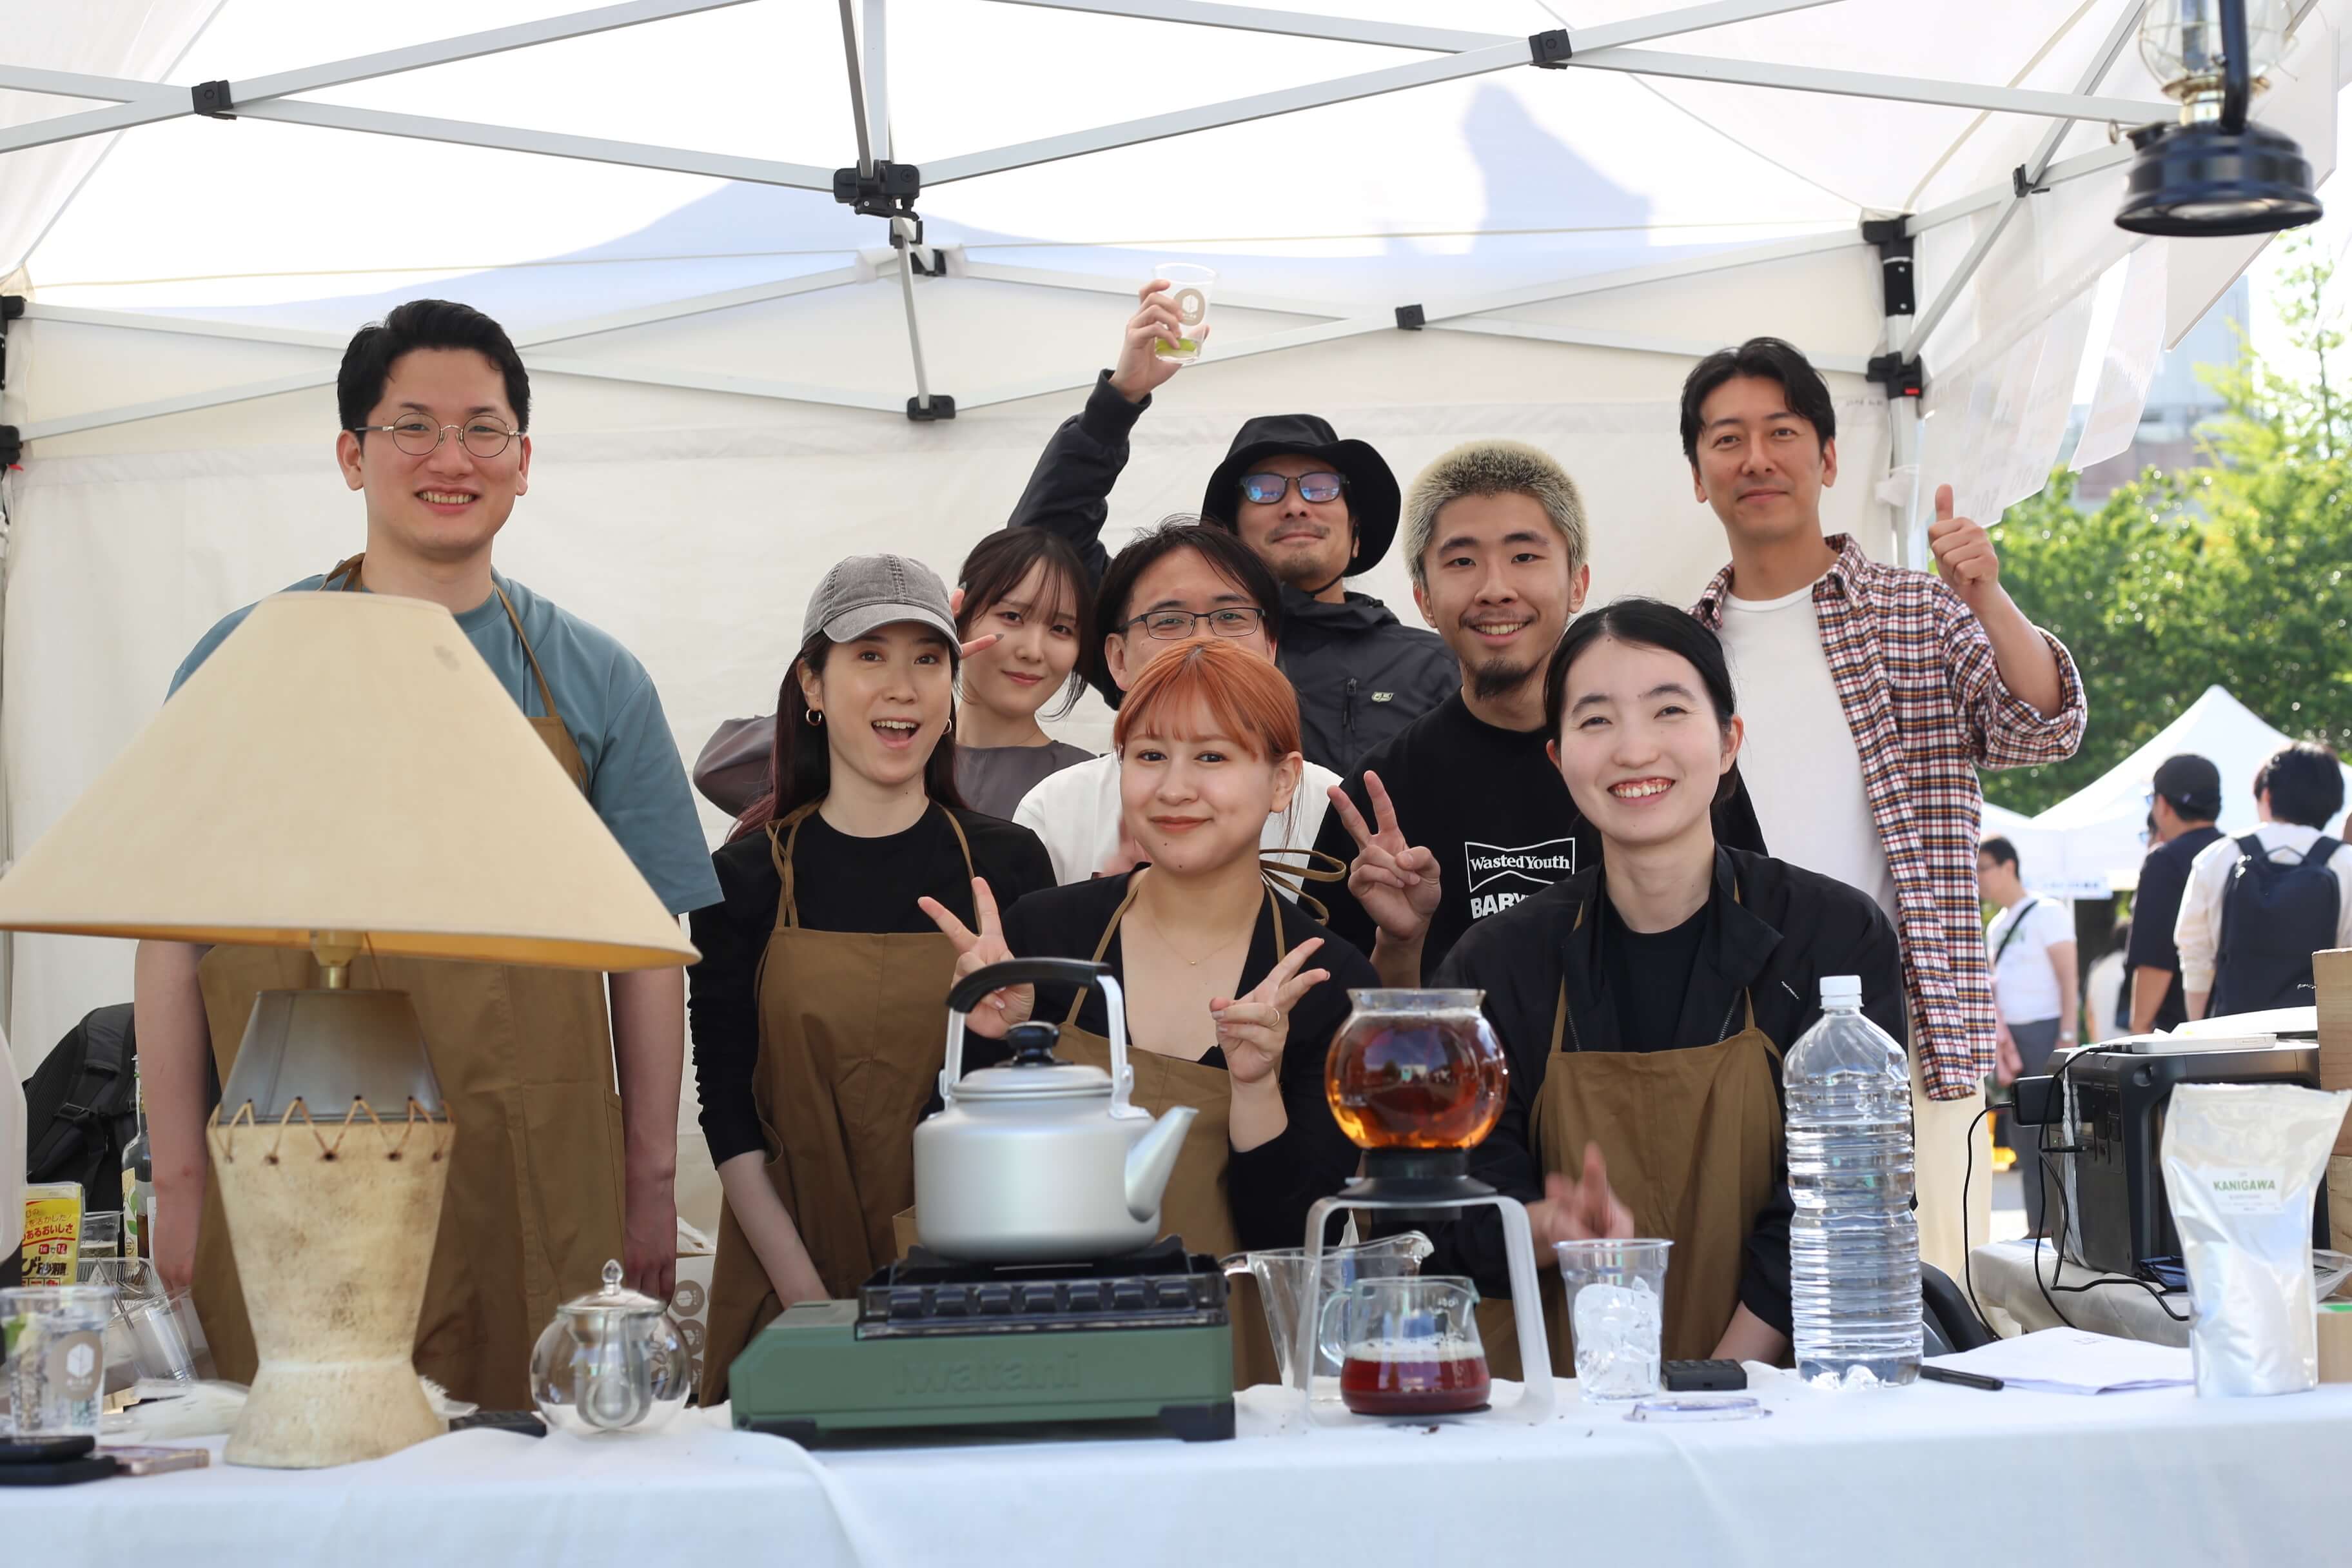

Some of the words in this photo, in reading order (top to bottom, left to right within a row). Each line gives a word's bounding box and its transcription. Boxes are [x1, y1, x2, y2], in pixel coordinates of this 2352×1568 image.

[1469, 854, 1524, 872] Wasted
[1525, 855, 1571, 870] Youth
[2213, 1179, 2277, 1191] KANIGAWA
